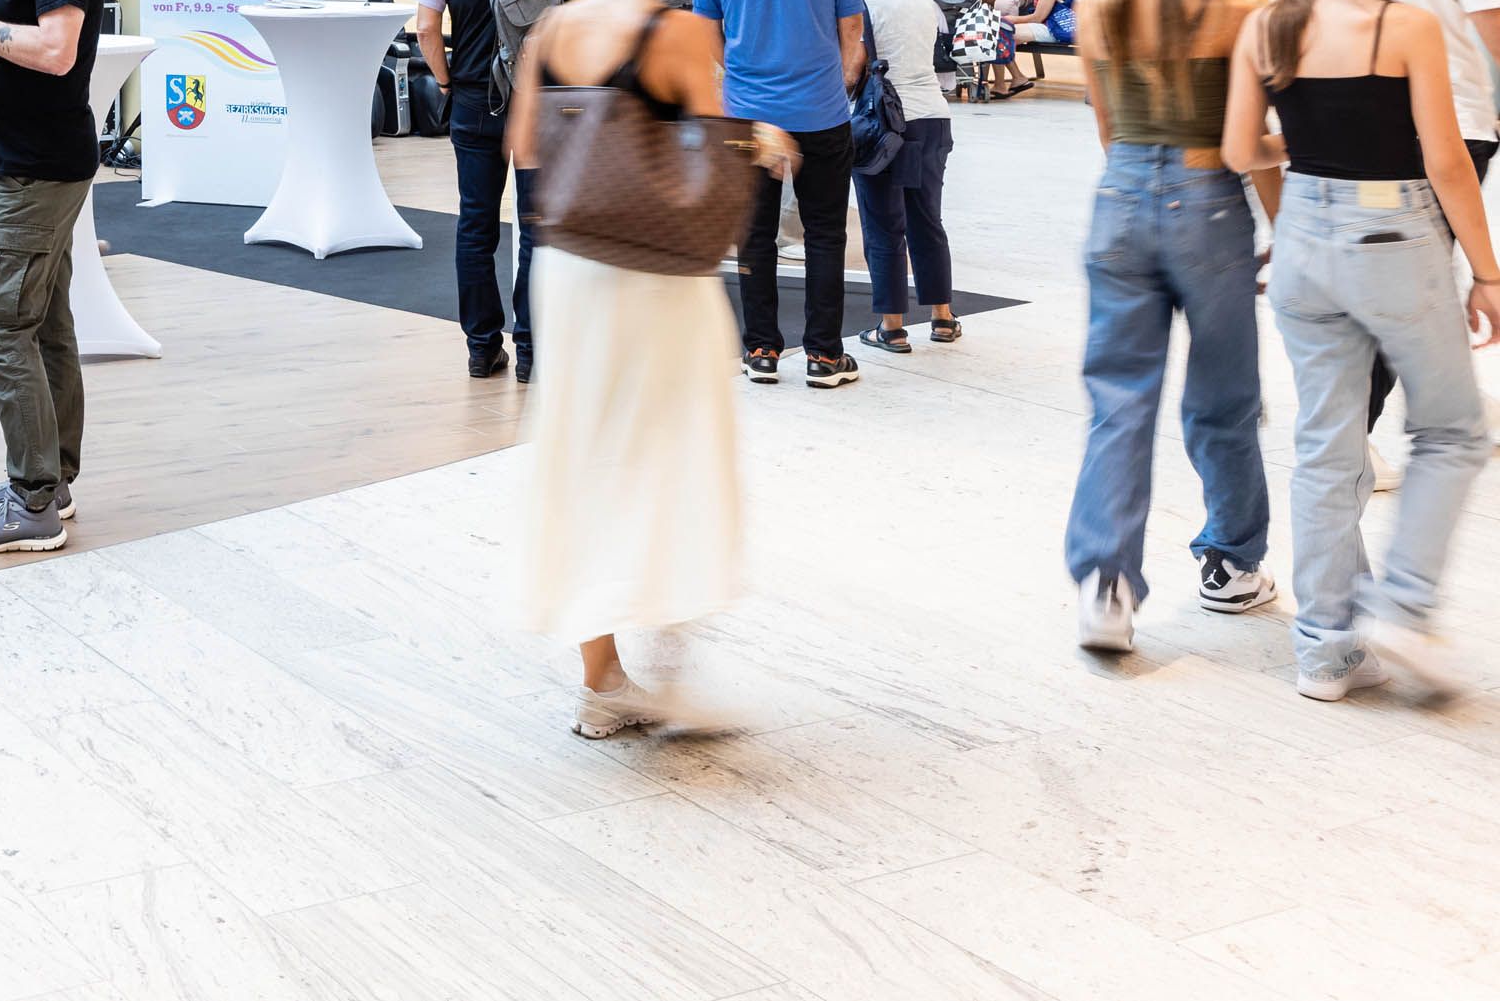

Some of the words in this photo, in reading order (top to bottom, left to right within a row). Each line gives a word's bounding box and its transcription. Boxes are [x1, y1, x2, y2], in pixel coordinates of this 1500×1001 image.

[153, 3, 173, 12] von
[175, 2, 192, 13] Fr,
[194, 2, 215, 13] 9.9.
